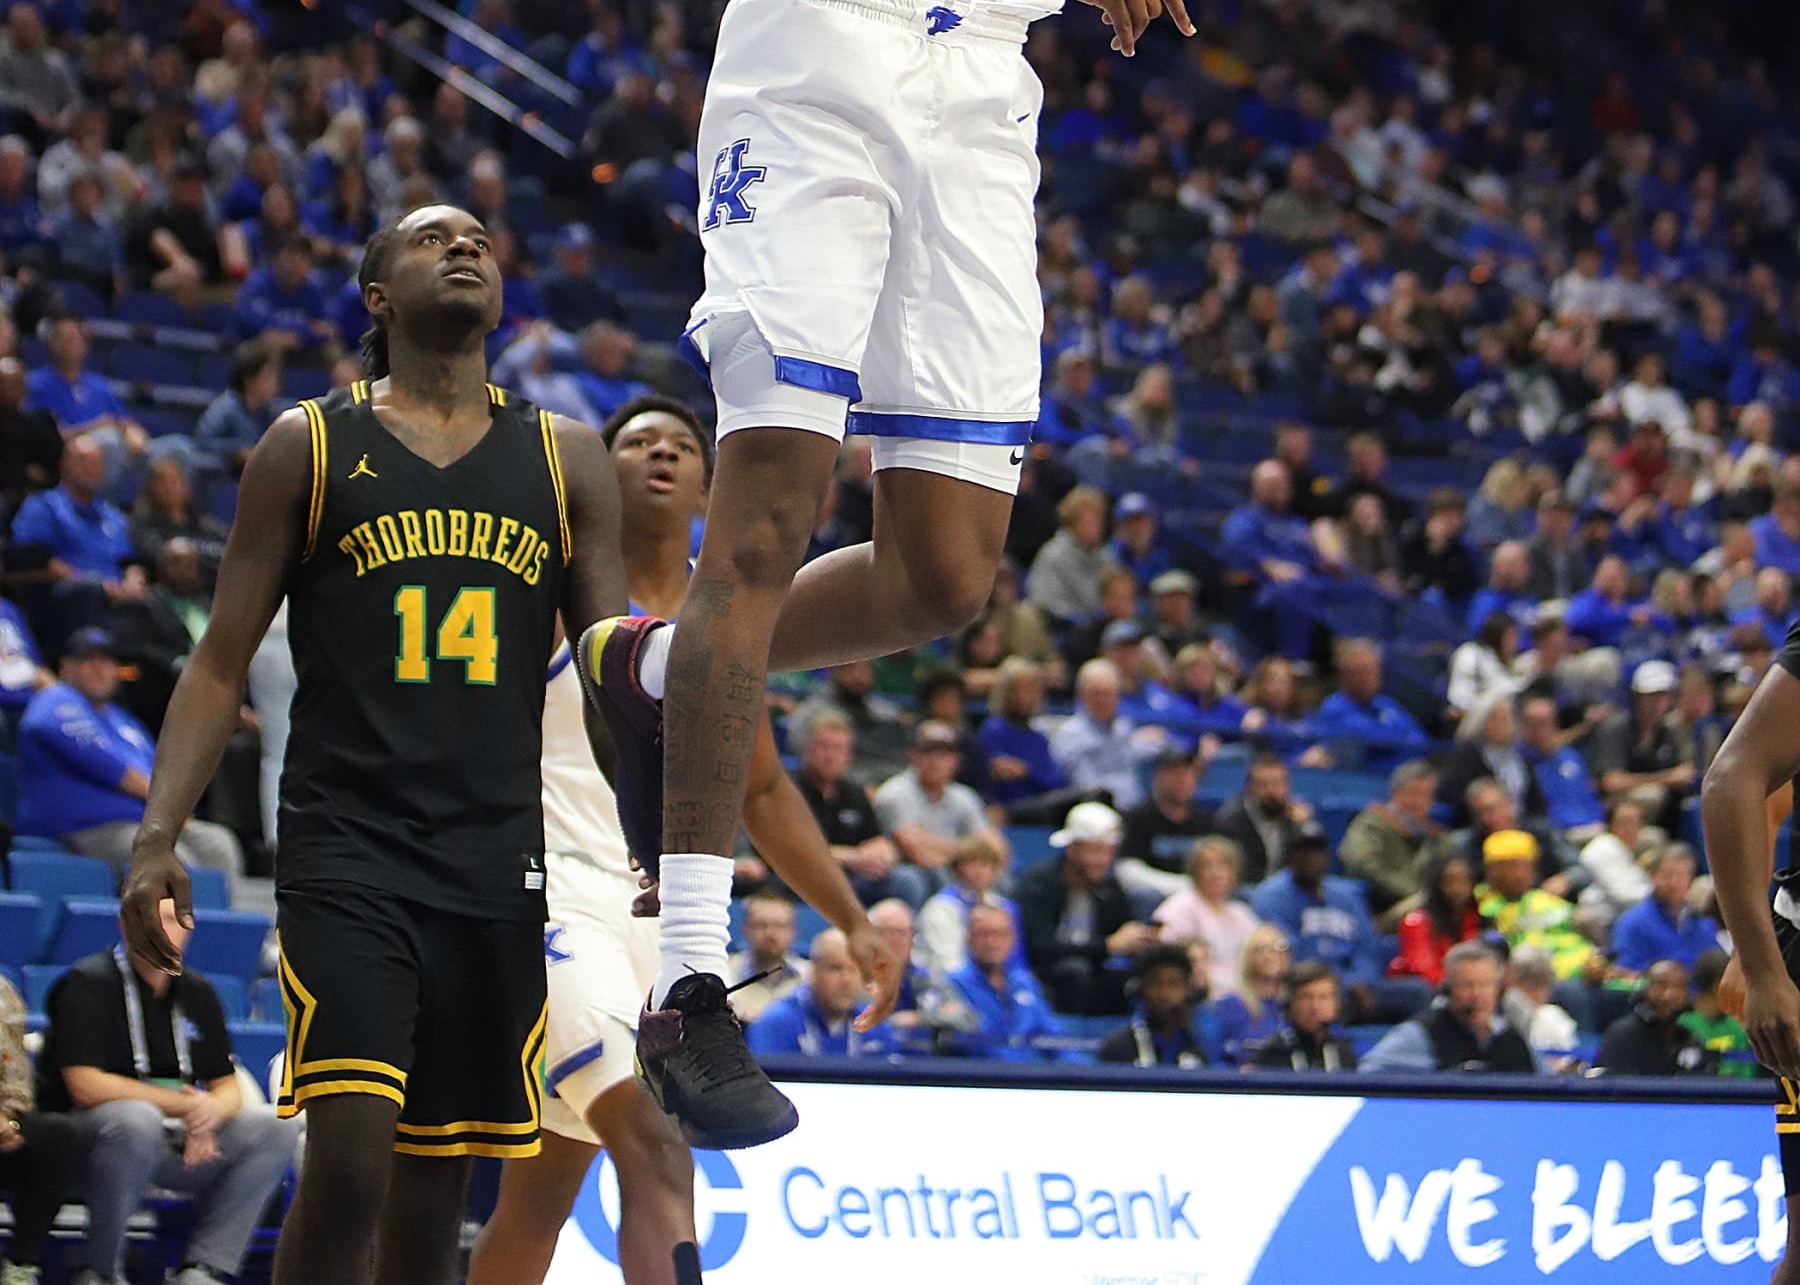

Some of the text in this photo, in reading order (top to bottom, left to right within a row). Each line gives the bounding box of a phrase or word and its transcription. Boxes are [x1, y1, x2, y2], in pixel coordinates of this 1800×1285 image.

[702, 138, 768, 233] UK
[337, 509, 549, 586] THOROBREDS
[393, 585, 499, 686] 14
[781, 1166, 1200, 1239] Central Bank
[1349, 1157, 1507, 1268] WE
